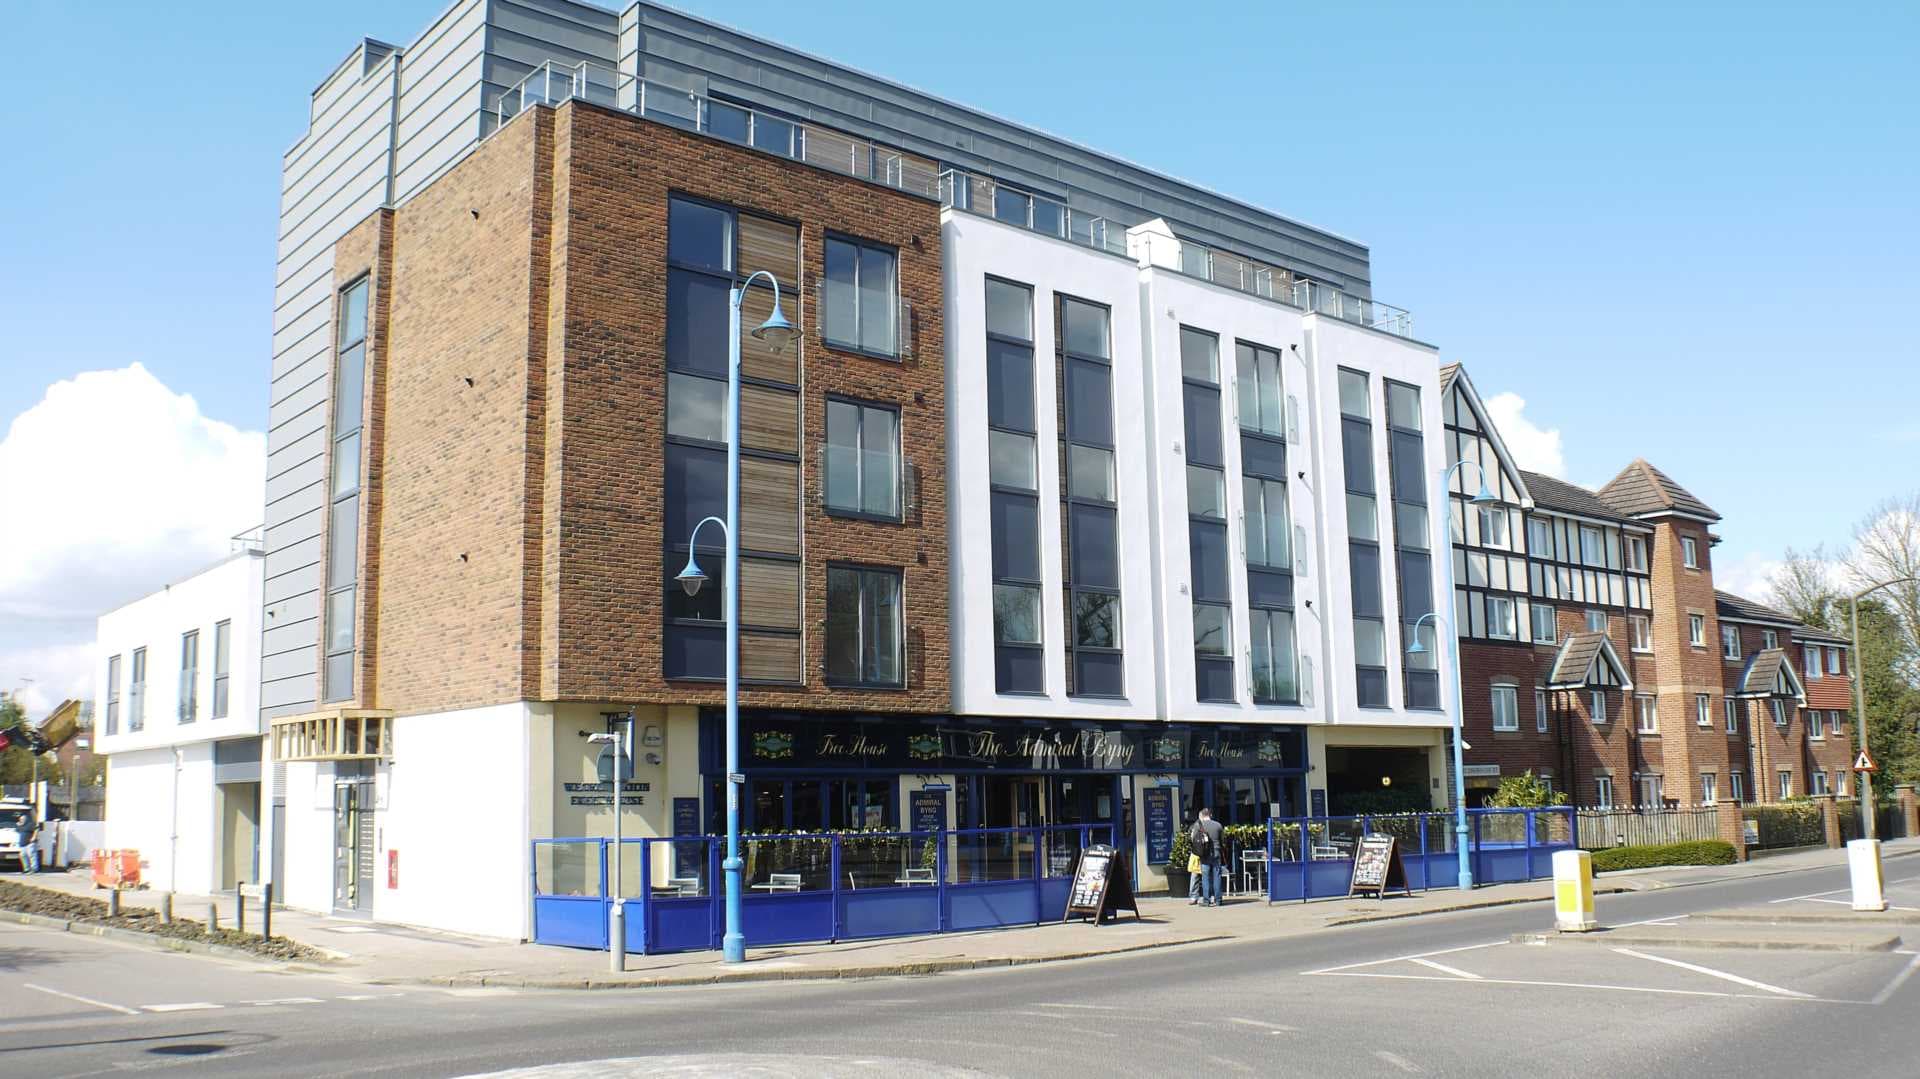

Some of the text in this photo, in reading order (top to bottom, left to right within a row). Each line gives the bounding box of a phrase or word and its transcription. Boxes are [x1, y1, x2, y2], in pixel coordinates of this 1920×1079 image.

[968, 729, 1136, 766] The Admiral Byng
